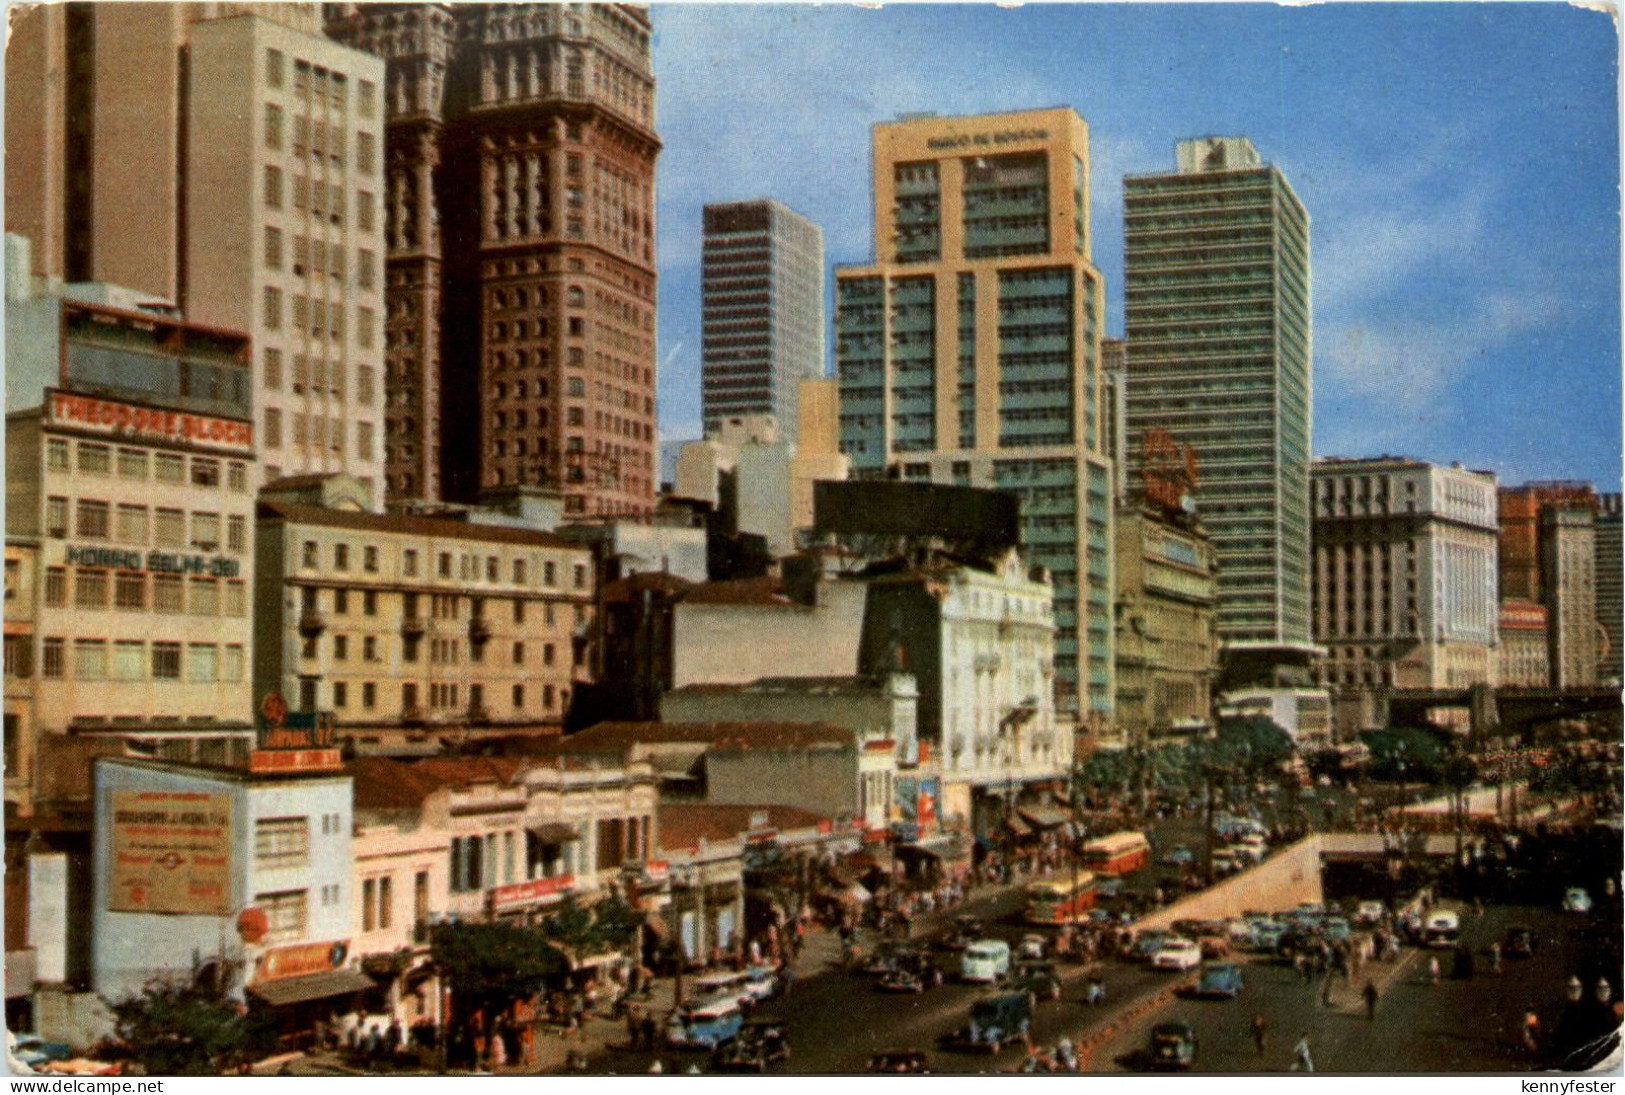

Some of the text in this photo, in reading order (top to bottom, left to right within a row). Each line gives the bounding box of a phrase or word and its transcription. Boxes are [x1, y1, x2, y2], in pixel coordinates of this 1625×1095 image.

[52, 394, 253, 445] THEODORE BLOCH
[65, 545, 142, 571] MOINHO
